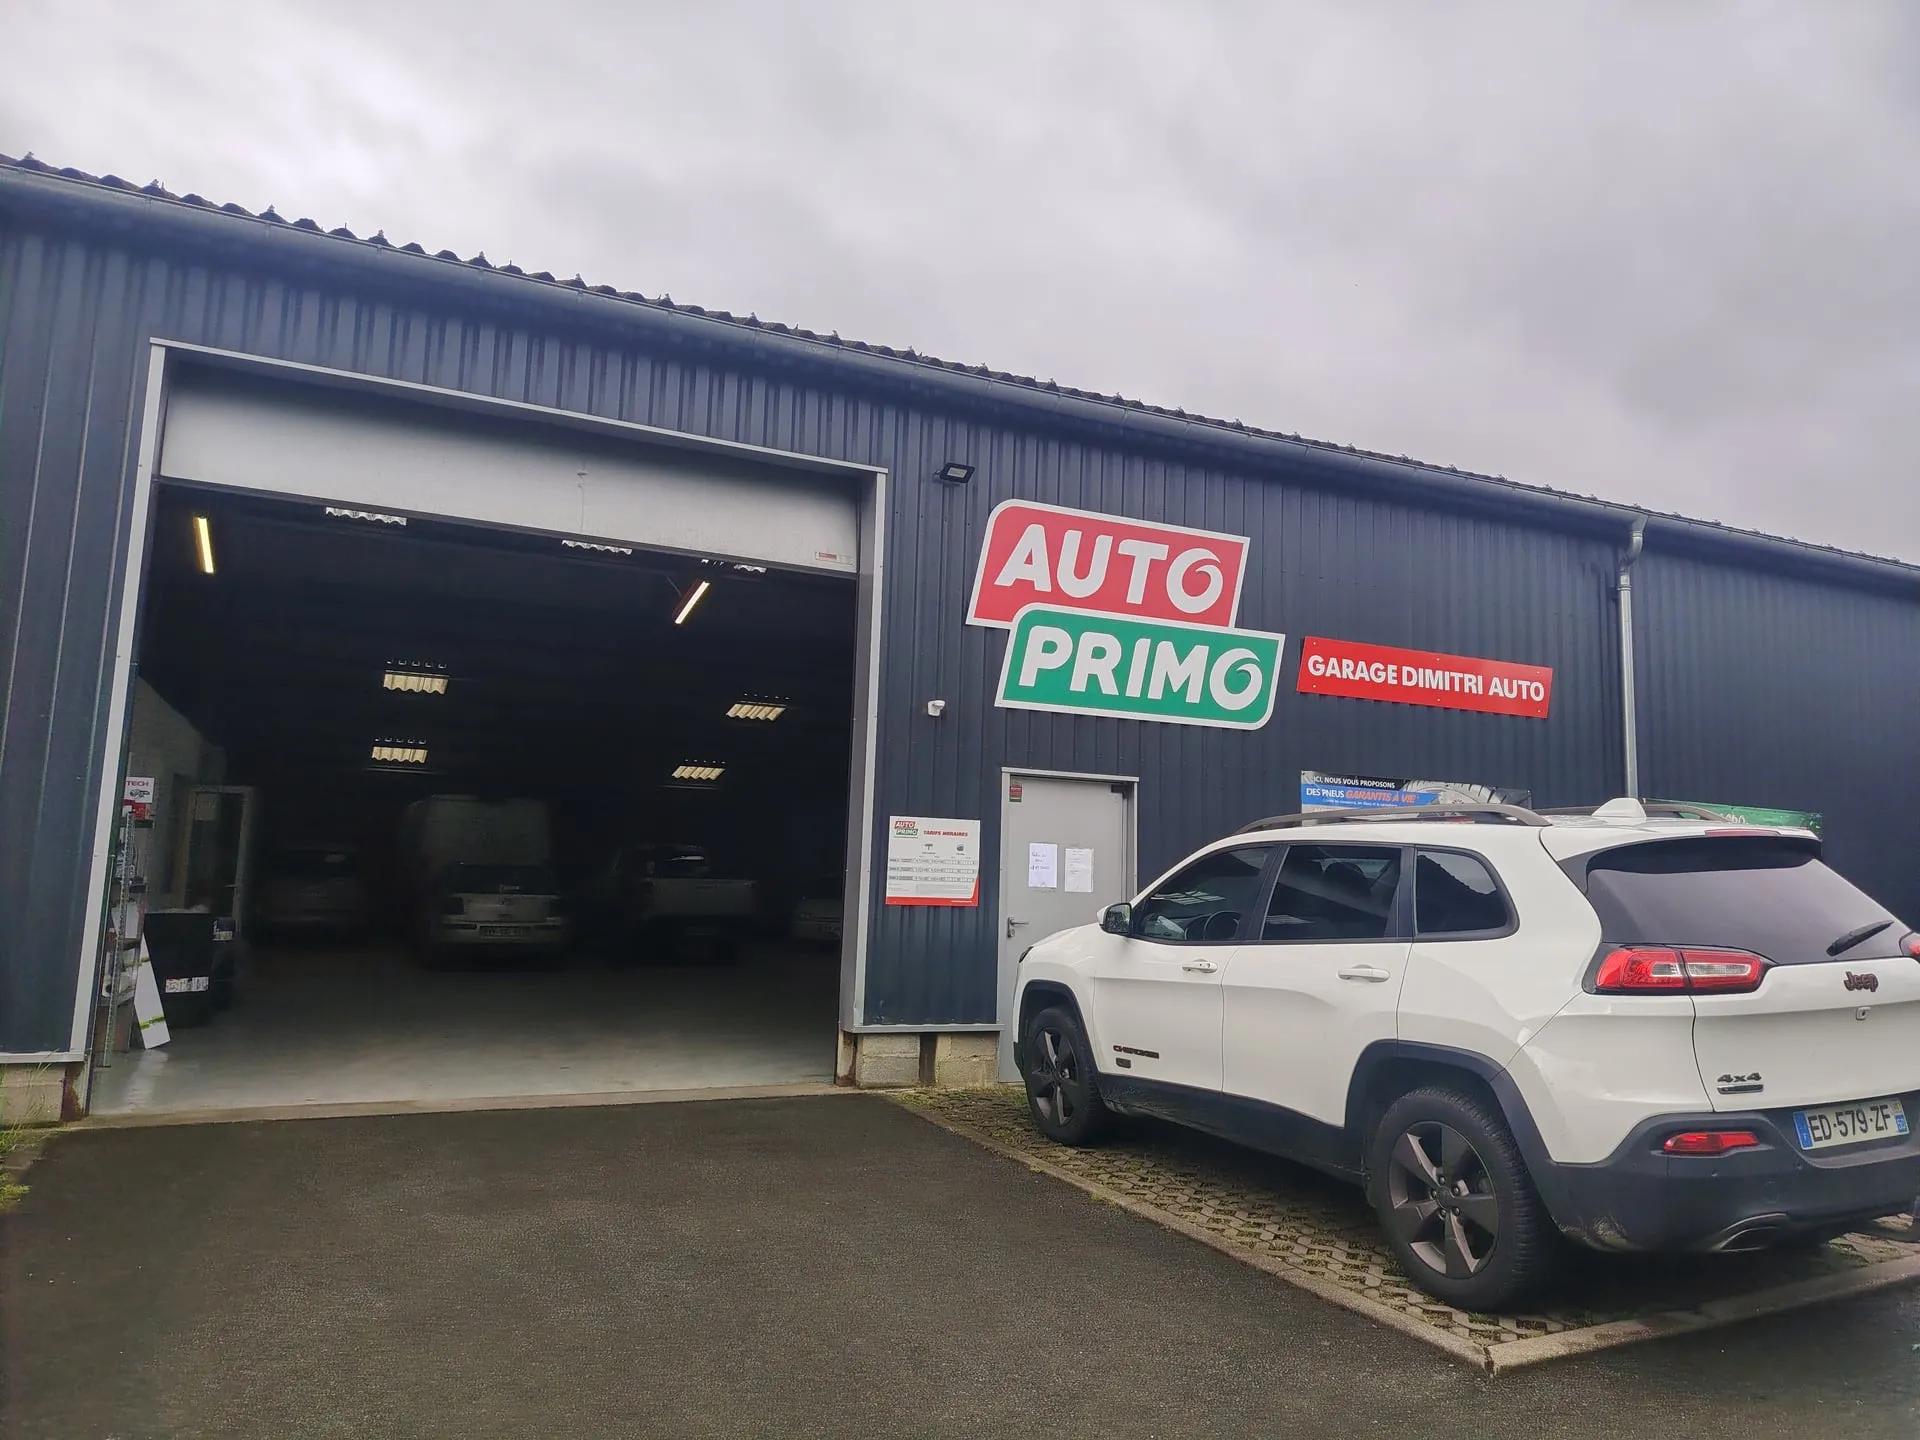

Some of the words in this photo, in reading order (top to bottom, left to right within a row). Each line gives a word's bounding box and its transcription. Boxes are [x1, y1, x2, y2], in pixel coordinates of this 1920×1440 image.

[994, 524, 1224, 614] AUTO
[1018, 625, 1263, 711] PRIMO
[1307, 654, 1398, 685] GARAGE
[1402, 665, 1483, 695] DIMITRI
[1488, 677, 1545, 702] AUTO
[1324, 776, 1342, 785] NOUS
[1342, 778, 1359, 786] VOUS
[1360, 779, 1396, 789] PROPOSONS
[1306, 787, 1321, 796] DES
[1321, 788, 1345, 799] PNEUS
[1345, 790, 1392, 802] GARANTIS
[1843, 971, 1879, 992] Jeep
[1717, 1072, 1762, 1083] 4x4
